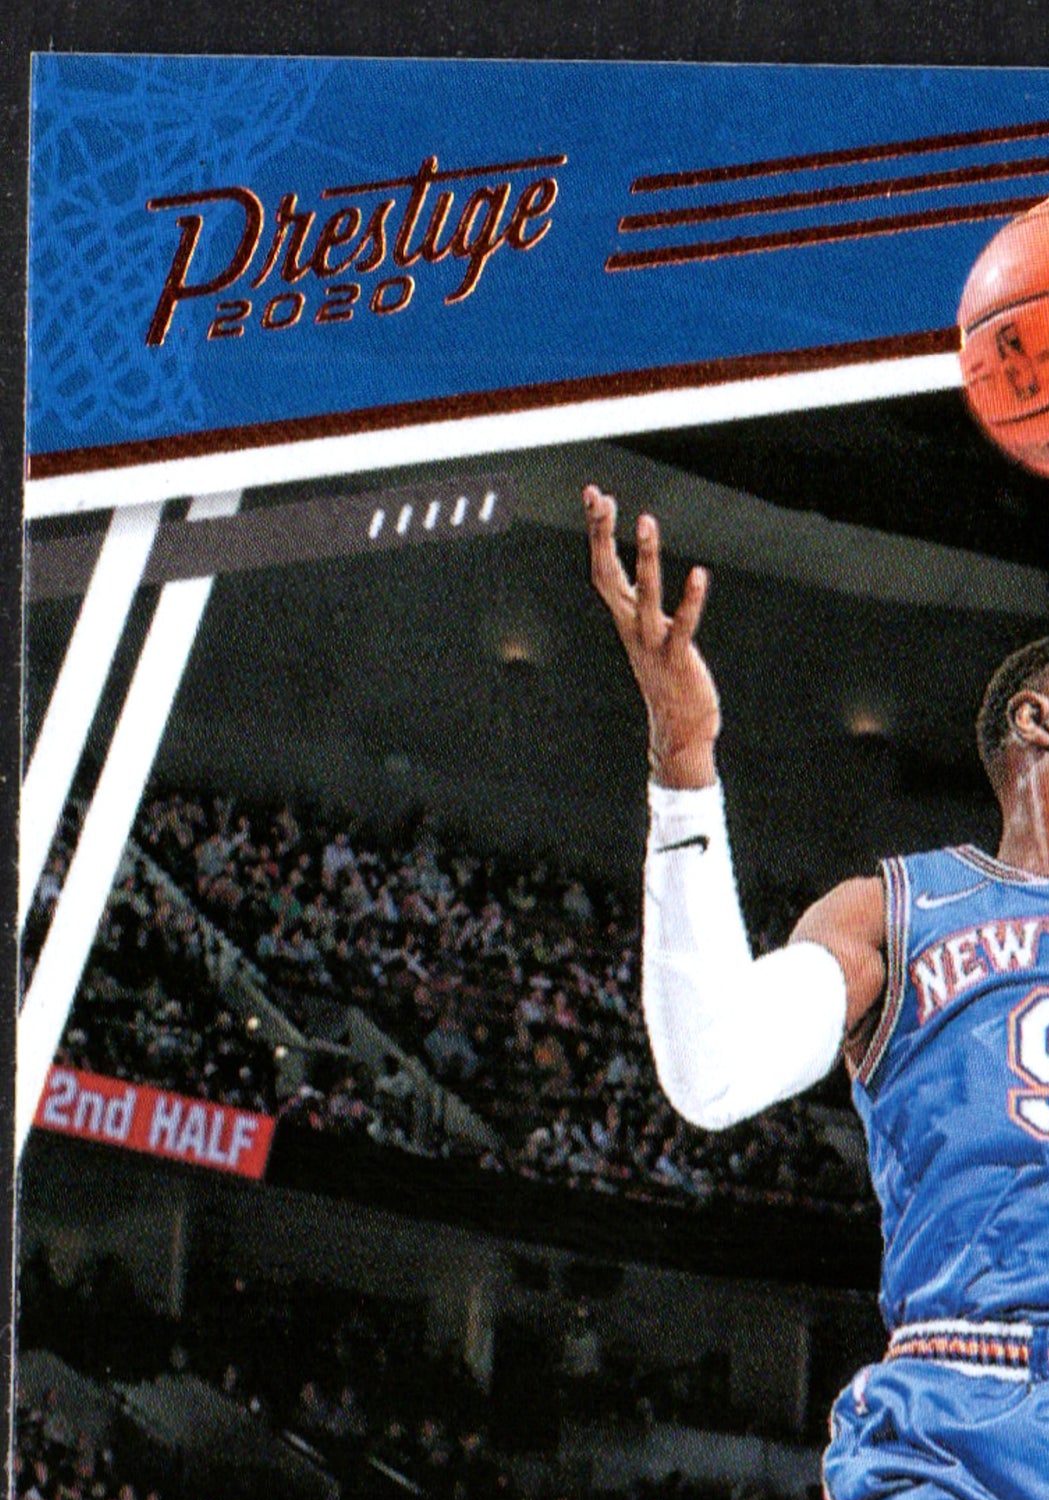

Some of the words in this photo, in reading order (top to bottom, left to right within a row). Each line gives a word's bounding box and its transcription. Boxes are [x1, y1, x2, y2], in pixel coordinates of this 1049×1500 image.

[146, 155, 567, 347] Prestige
[207, 276, 414, 341] 2020
[909, 917, 1042, 1026] NEW
[43, 1070, 138, 1142] 2nd
[148, 1096, 258, 1168] HALF
